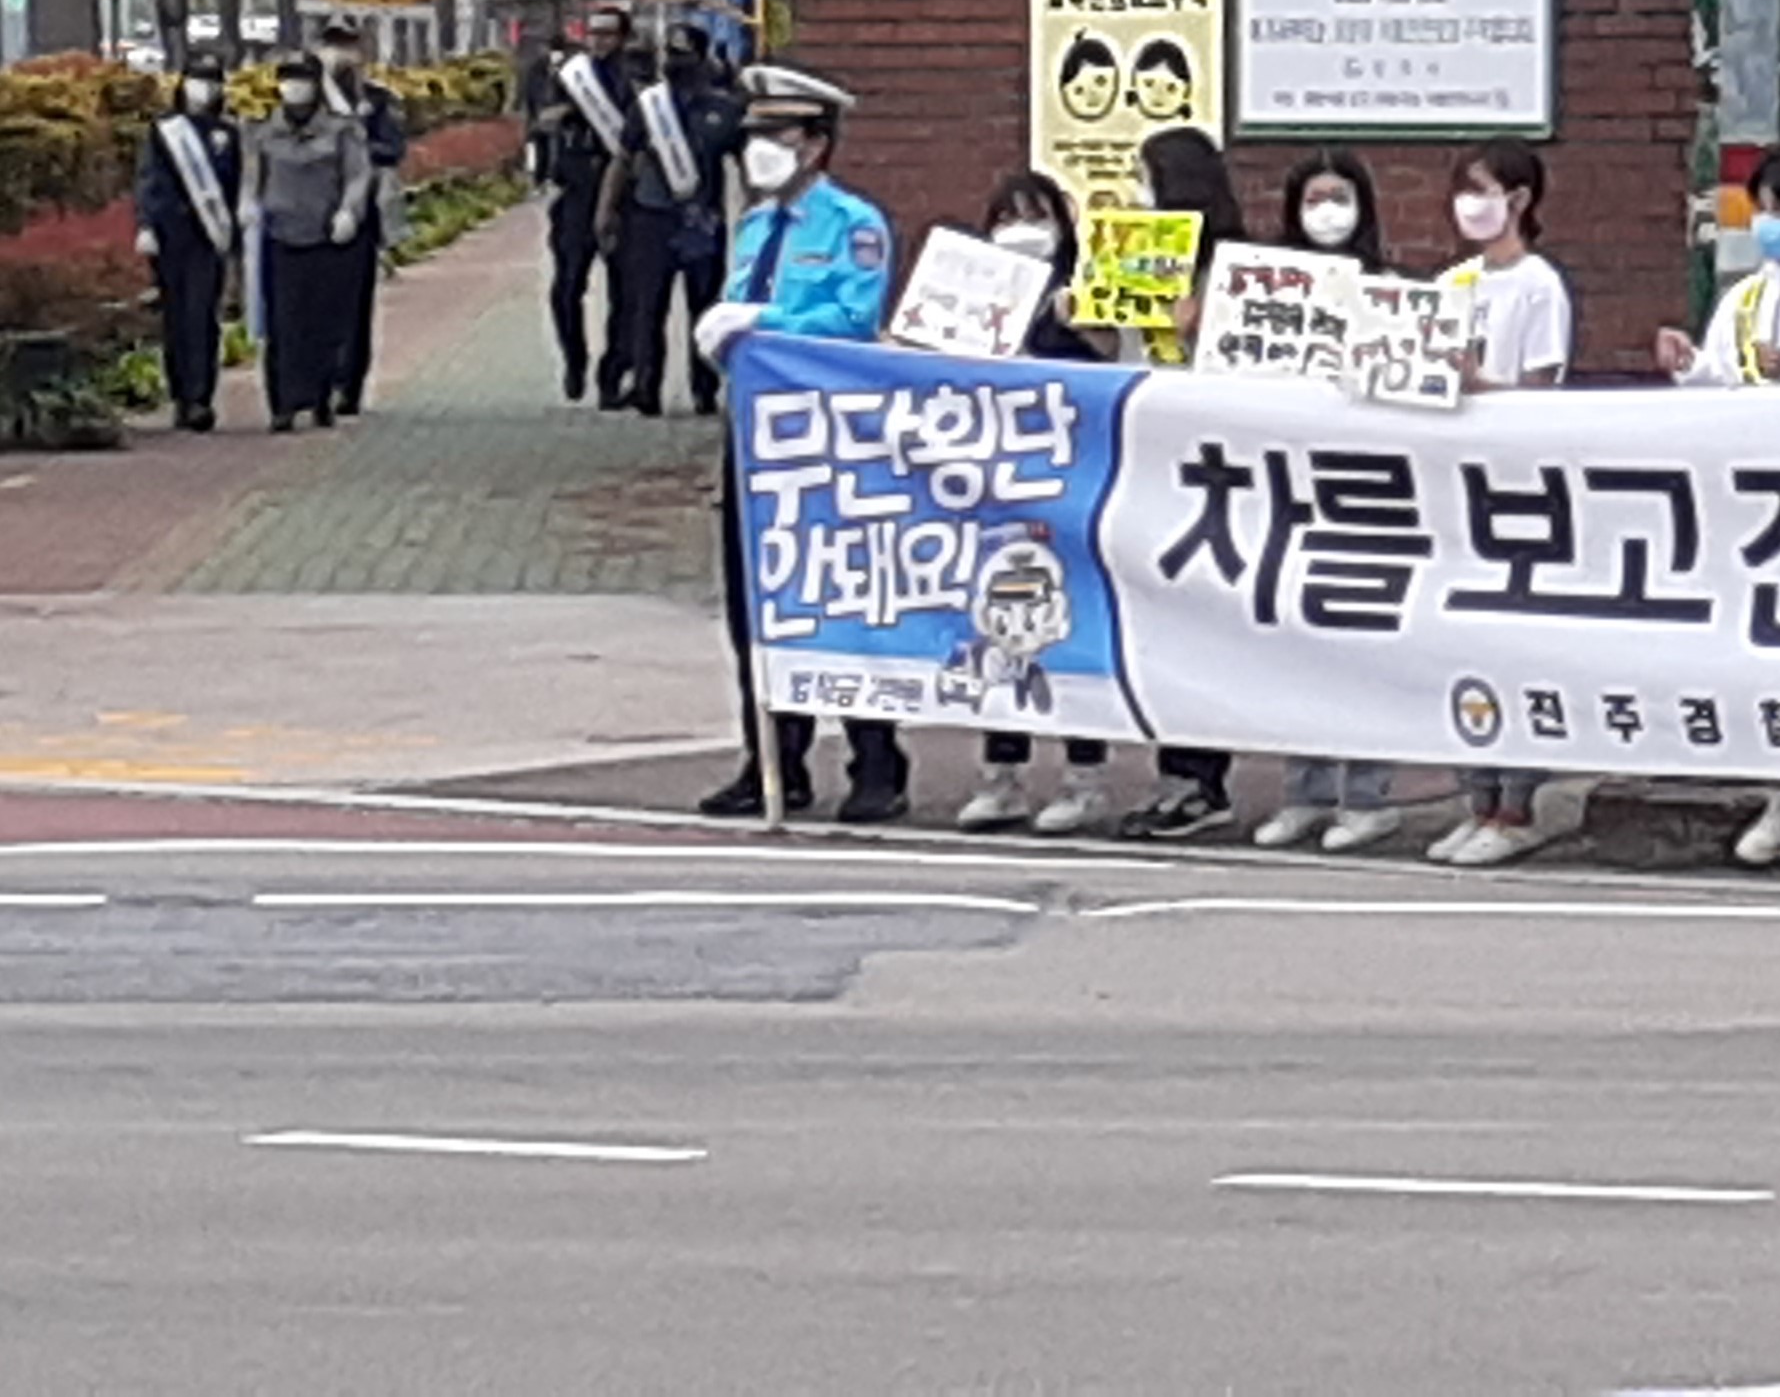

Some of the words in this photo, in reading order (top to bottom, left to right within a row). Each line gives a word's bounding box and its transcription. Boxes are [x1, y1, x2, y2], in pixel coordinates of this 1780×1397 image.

[750, 382, 1078, 529] 무단횡단
[1158, 441, 1435, 632] 차를
[1443, 462, 1715, 624] 보고
